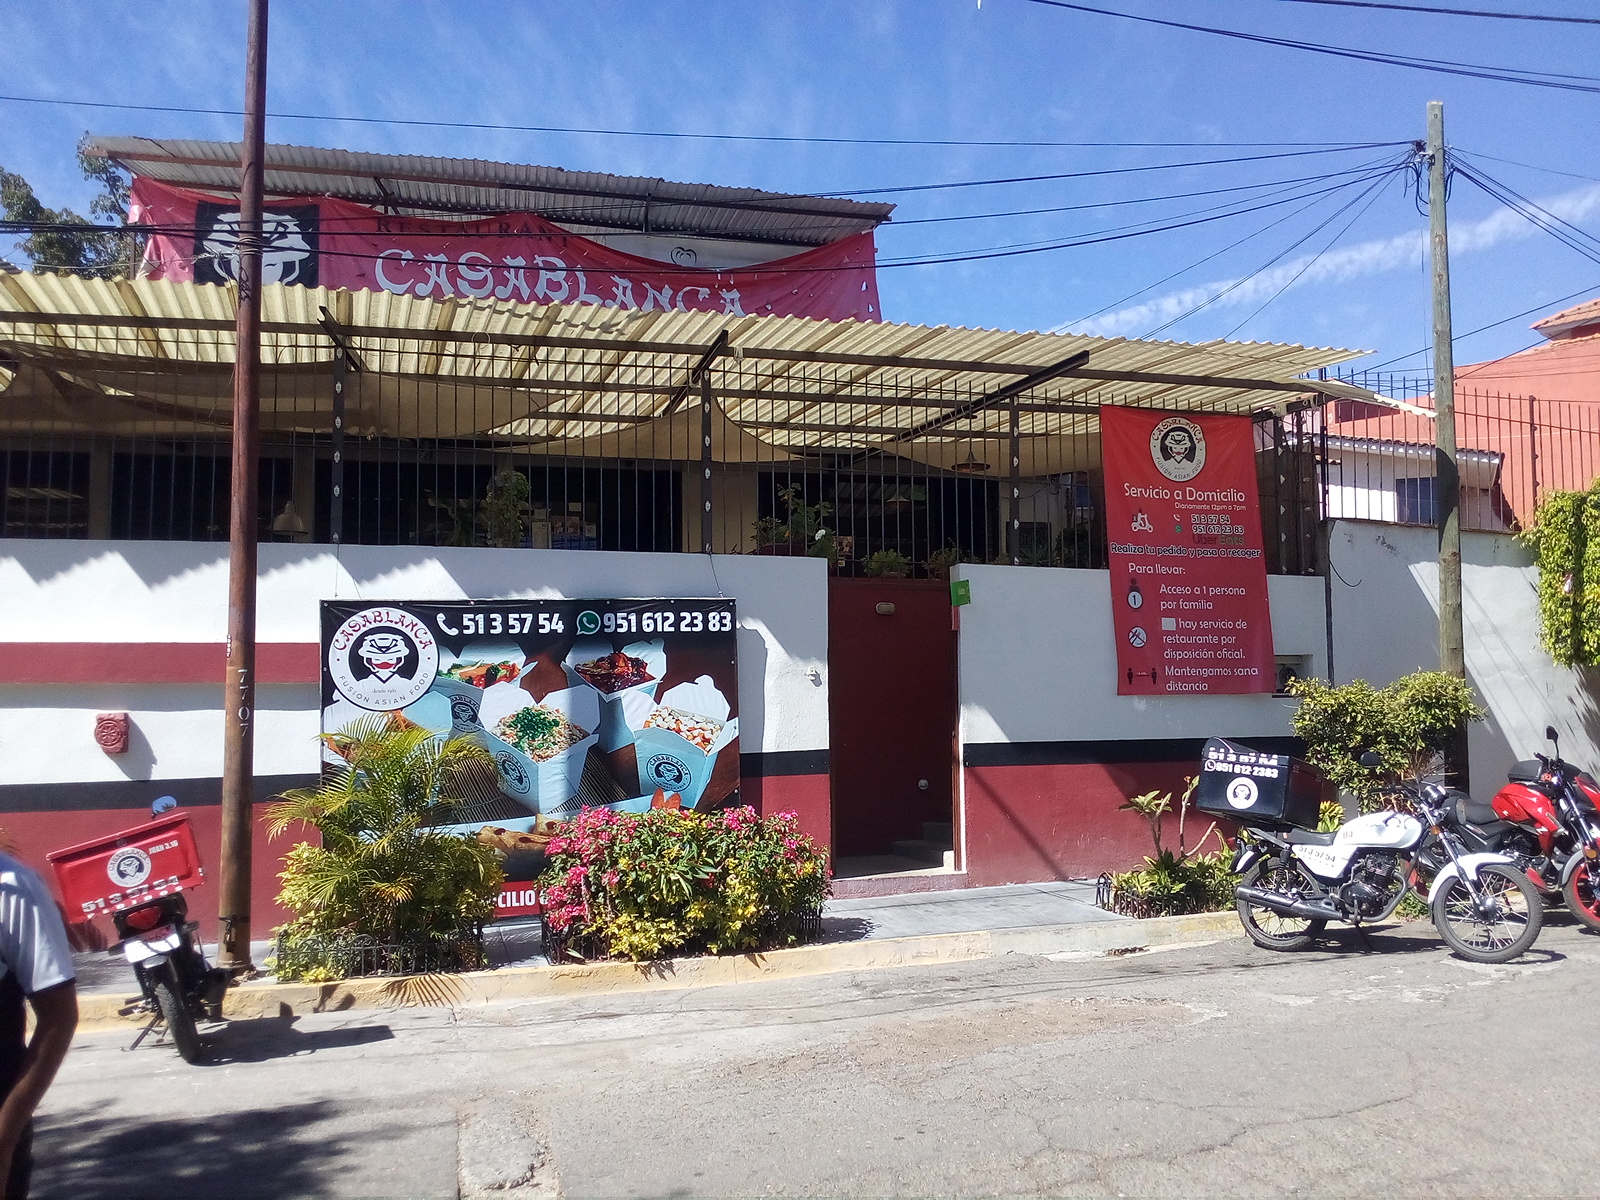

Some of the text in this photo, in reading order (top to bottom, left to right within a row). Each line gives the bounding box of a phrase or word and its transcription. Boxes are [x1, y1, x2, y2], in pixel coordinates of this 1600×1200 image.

[375, 249, 747, 317] CASABLANCA
[1124, 483, 1245, 502] Servicio a Domicilio
[1175, 502, 1210, 510] Diariamente
[1191, 514, 1230, 524] 51 3 57 54
[1193, 525, 1244, 535] 951 612 23 83
[1193, 535, 1244, 545] Uber Eats
[1110, 542, 1144, 554] Realiza
[1145, 544, 1155, 554] tu
[1157, 544, 1187, 556] pedido
[1187, 548, 1195, 557] y
[1197, 549, 1218, 557] pasa
[1229, 549, 1260, 558] recoger
[1128, 563, 1186, 574] Para llevar:
[1160, 584, 1191, 594] Acceso
[1203, 586, 1206, 594] 1
[1209, 587, 1245, 596] persona
[1160, 599, 1213, 610] por familia
[462, 613, 564, 634] 51 3 57 54
[604, 612, 732, 633] 951 612 23 83
[1179, 618, 1247, 630] hay servicio de
[333, 611, 433, 650] CASABLANCA
[1163, 634, 1237, 645] restaurante por
[1164, 648, 1246, 660] disposición oficial.
[1165, 665, 1258, 677] Mantengamos sana
[339, 672, 428, 705] FUSION ASIAN FOOD
[1166, 681, 1208, 691] distancia
[81, 898, 105, 913] 51
[108, 893, 122, 904] 3
[126, 884, 149, 898] 57
[153, 875, 179, 890] 54
[497, 890, 535, 908] CILIO
